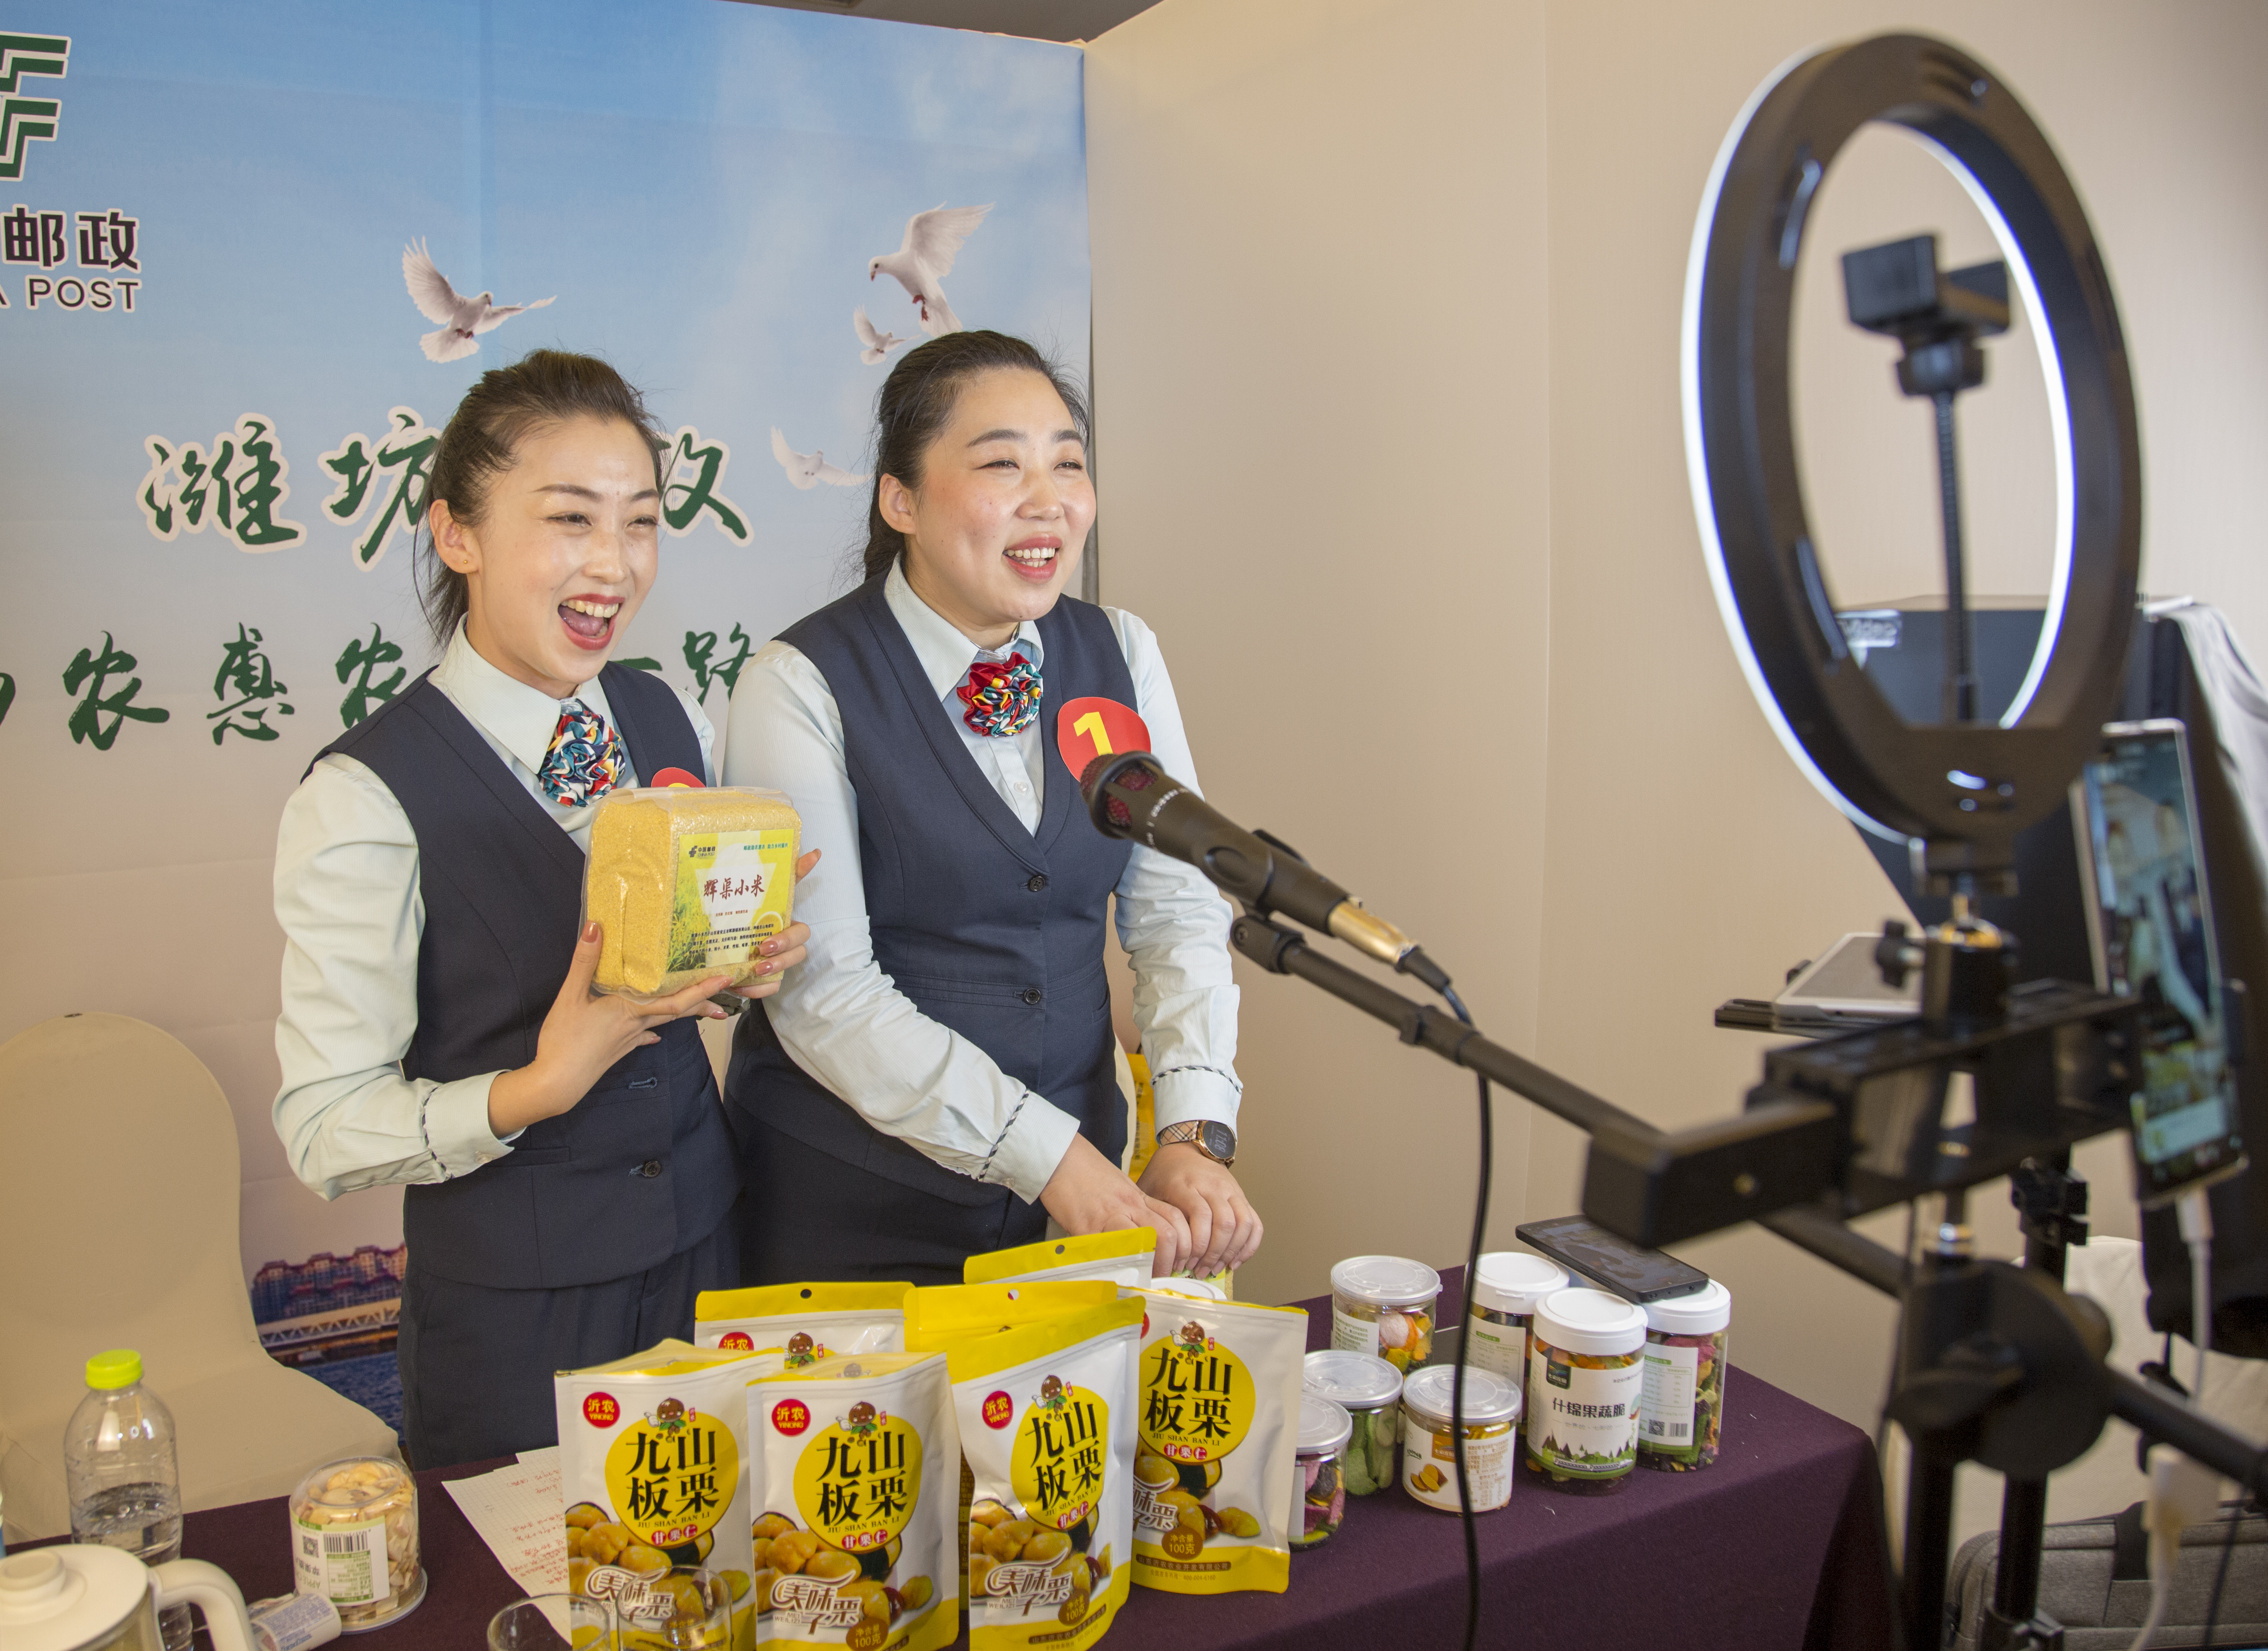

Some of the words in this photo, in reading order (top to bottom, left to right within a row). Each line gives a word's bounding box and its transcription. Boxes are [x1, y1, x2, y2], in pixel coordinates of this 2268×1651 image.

[4, 207, 138, 270] 邮政
[29, 278, 139, 310] POST
[1073, 711, 1114, 754] 1
[723, 1339, 749, 1350] 沂农
[1147, 1348, 1233, 1395] 九山
[587, 1399, 615, 1413] 沂农
[777, 1406, 805, 1421] 沂农
[986, 1397, 1009, 1416] 沂农
[1144, 1390, 1232, 1438] 板栗
[1552, 1397, 1626, 1418] 什锦果蔬脆
[989, 1411, 1010, 1424] YINONG
[1025, 1402, 1098, 1468] 九山
[626, 1428, 716, 1476] 九山
[816, 1431, 905, 1482] 九山
[1165, 1443, 1207, 1460] 甘栗仁
[1033, 1440, 1103, 1511] 板栗
[625, 1467, 719, 1521] 板栗
[816, 1470, 908, 1526] 板栗
[1045, 1508, 1057, 1516] JIU
[1059, 1498, 1075, 1511] SHAN
[1078, 1491, 1089, 1502] BAN
[654, 1519, 677, 1527] SHAN
[681, 1514, 698, 1523] BAN
[1057, 1501, 1089, 1529] 甘栗仁
[652, 1525, 697, 1545] 甘栗仁
[845, 1523, 867, 1532] SHAN
[871, 1520, 888, 1528] BAN
[843, 1530, 887, 1549] 甘栗仁
[1169, 1543, 1195, 1555] 100克
[1170, 1535, 1194, 1543] 净含量
[855, 1634, 882, 1649] 100克
